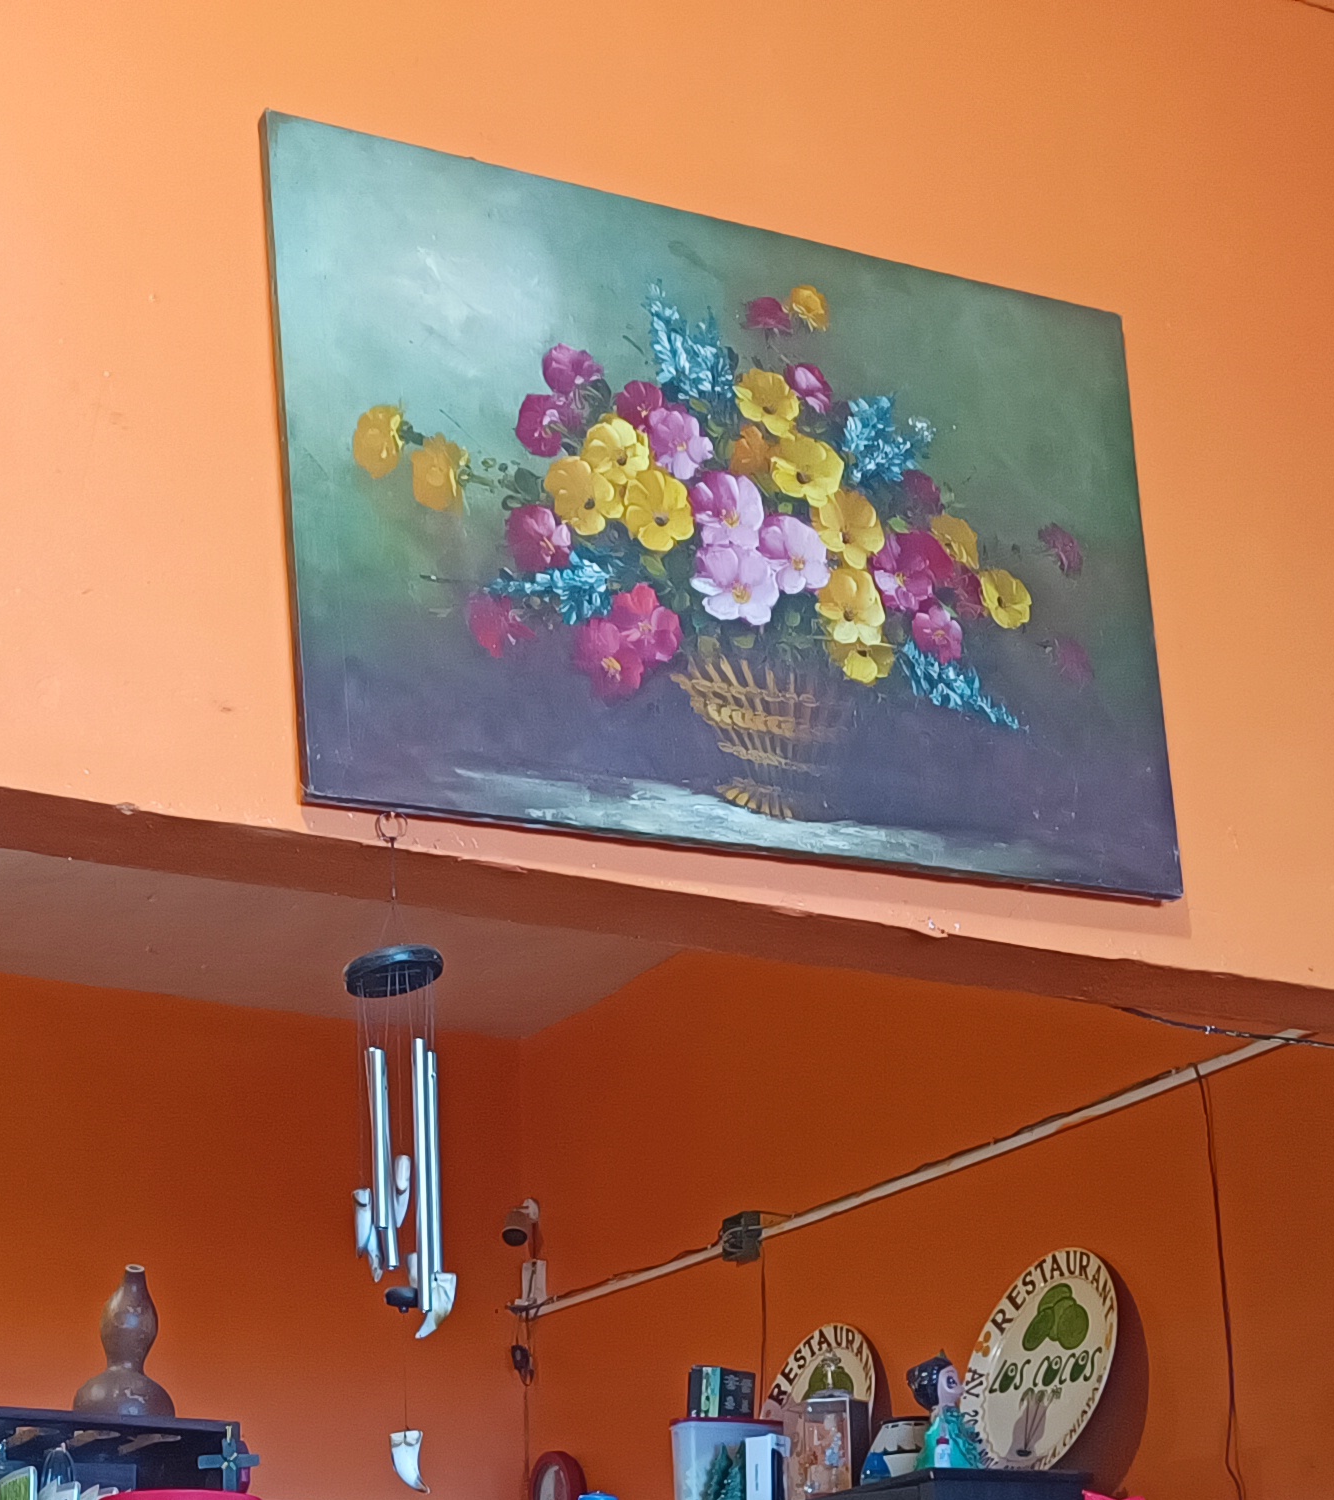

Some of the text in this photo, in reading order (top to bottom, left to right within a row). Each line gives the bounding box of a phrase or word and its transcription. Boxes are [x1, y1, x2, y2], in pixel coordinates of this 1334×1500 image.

[990, 1250, 1115, 1335] RESTAURANT
[988, 1347, 1103, 1394] LOS COCOS
